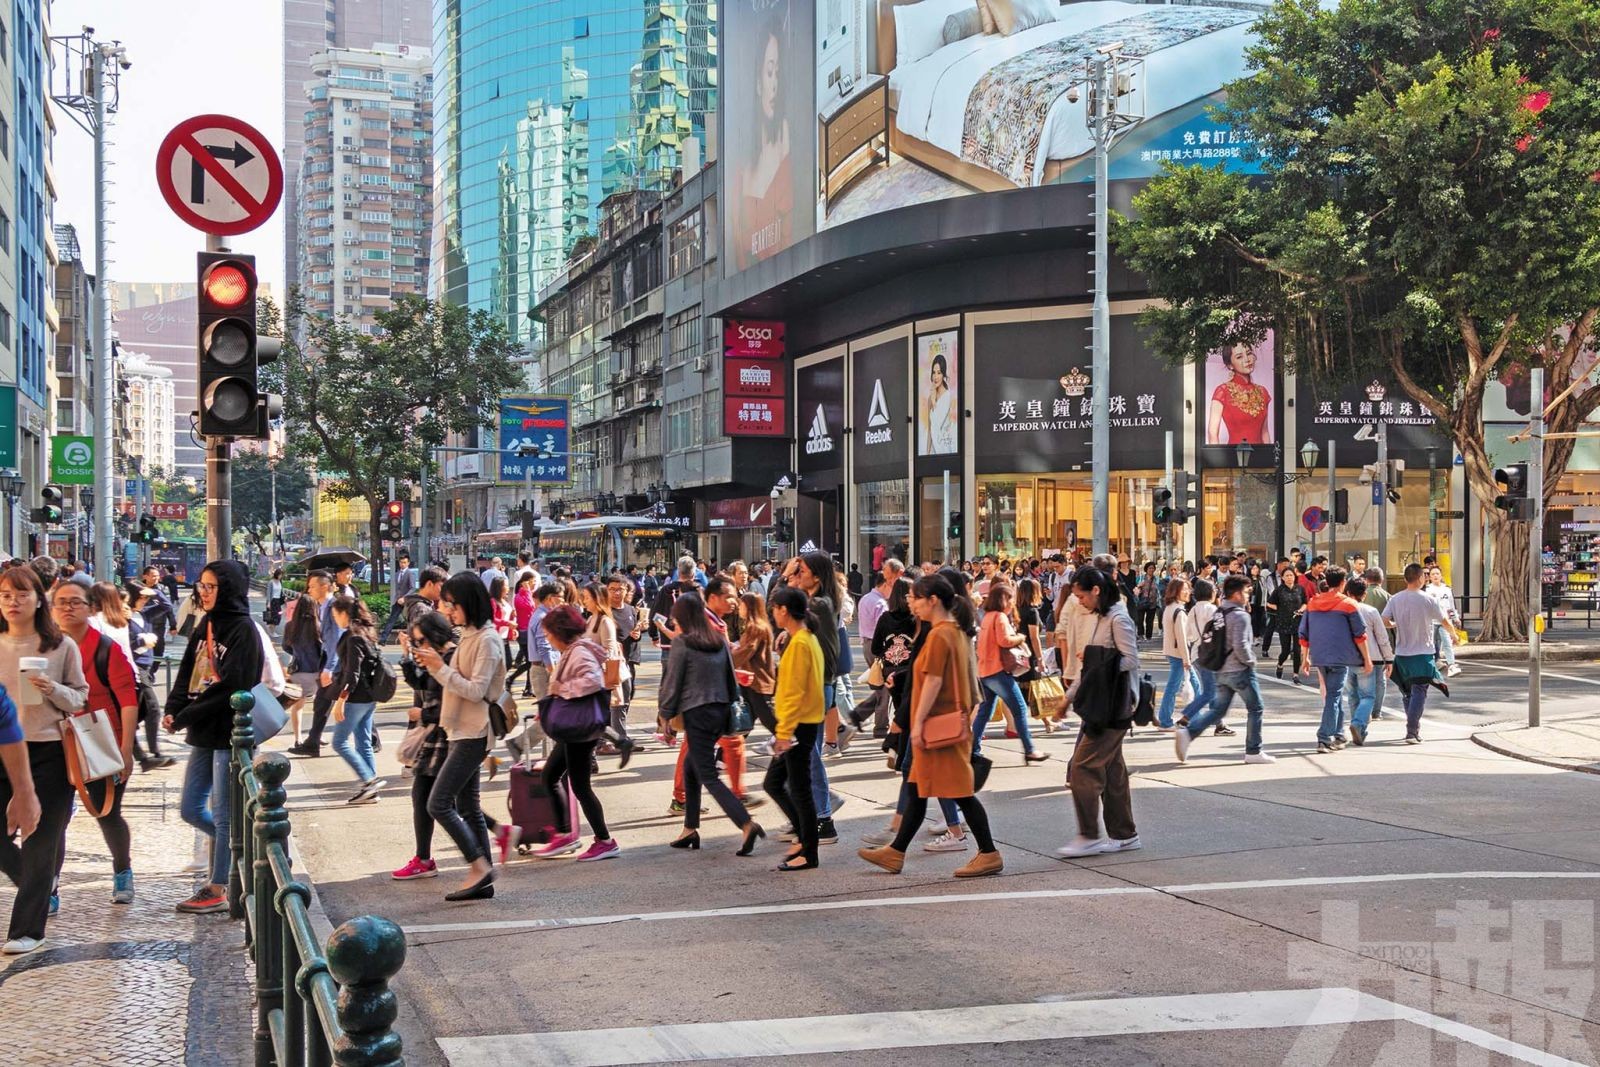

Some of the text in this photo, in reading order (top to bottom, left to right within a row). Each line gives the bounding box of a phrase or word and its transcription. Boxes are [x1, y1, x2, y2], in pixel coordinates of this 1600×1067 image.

[993, 417, 1162, 432] EMPEROR WATCH AN EWELLERY
[1350, 417, 1378, 425] WATCH
[864, 427, 892, 445] Reebok
[805, 434, 833, 455] adidas
